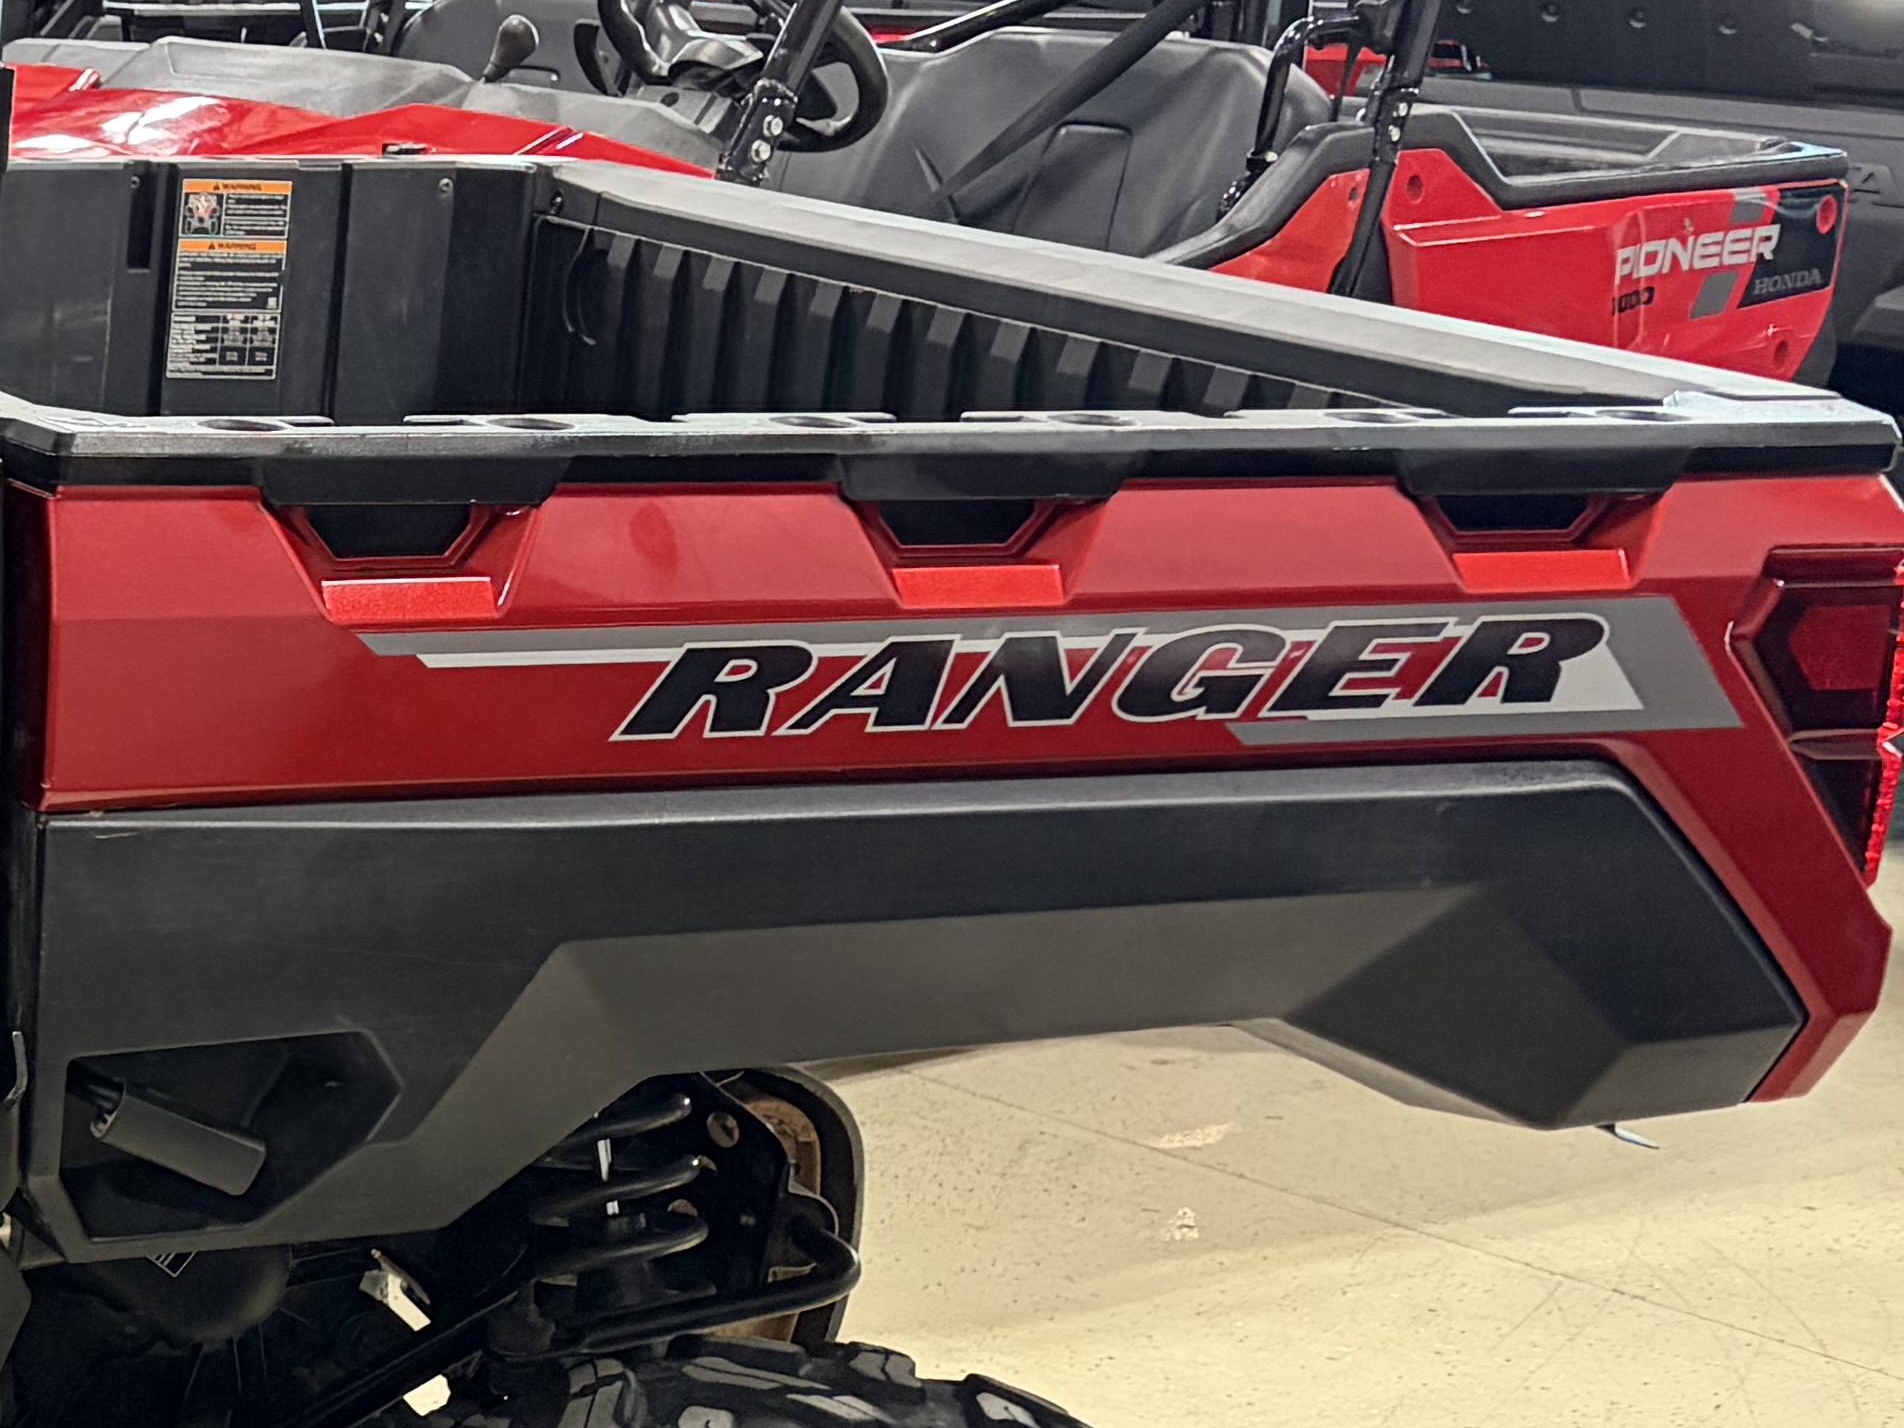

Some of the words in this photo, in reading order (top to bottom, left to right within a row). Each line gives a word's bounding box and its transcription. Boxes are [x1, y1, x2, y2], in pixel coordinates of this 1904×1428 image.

[1615, 224, 1781, 286] PIONEER
[1754, 269, 1823, 295] HONDA
[610, 615, 1610, 740] RANGER
